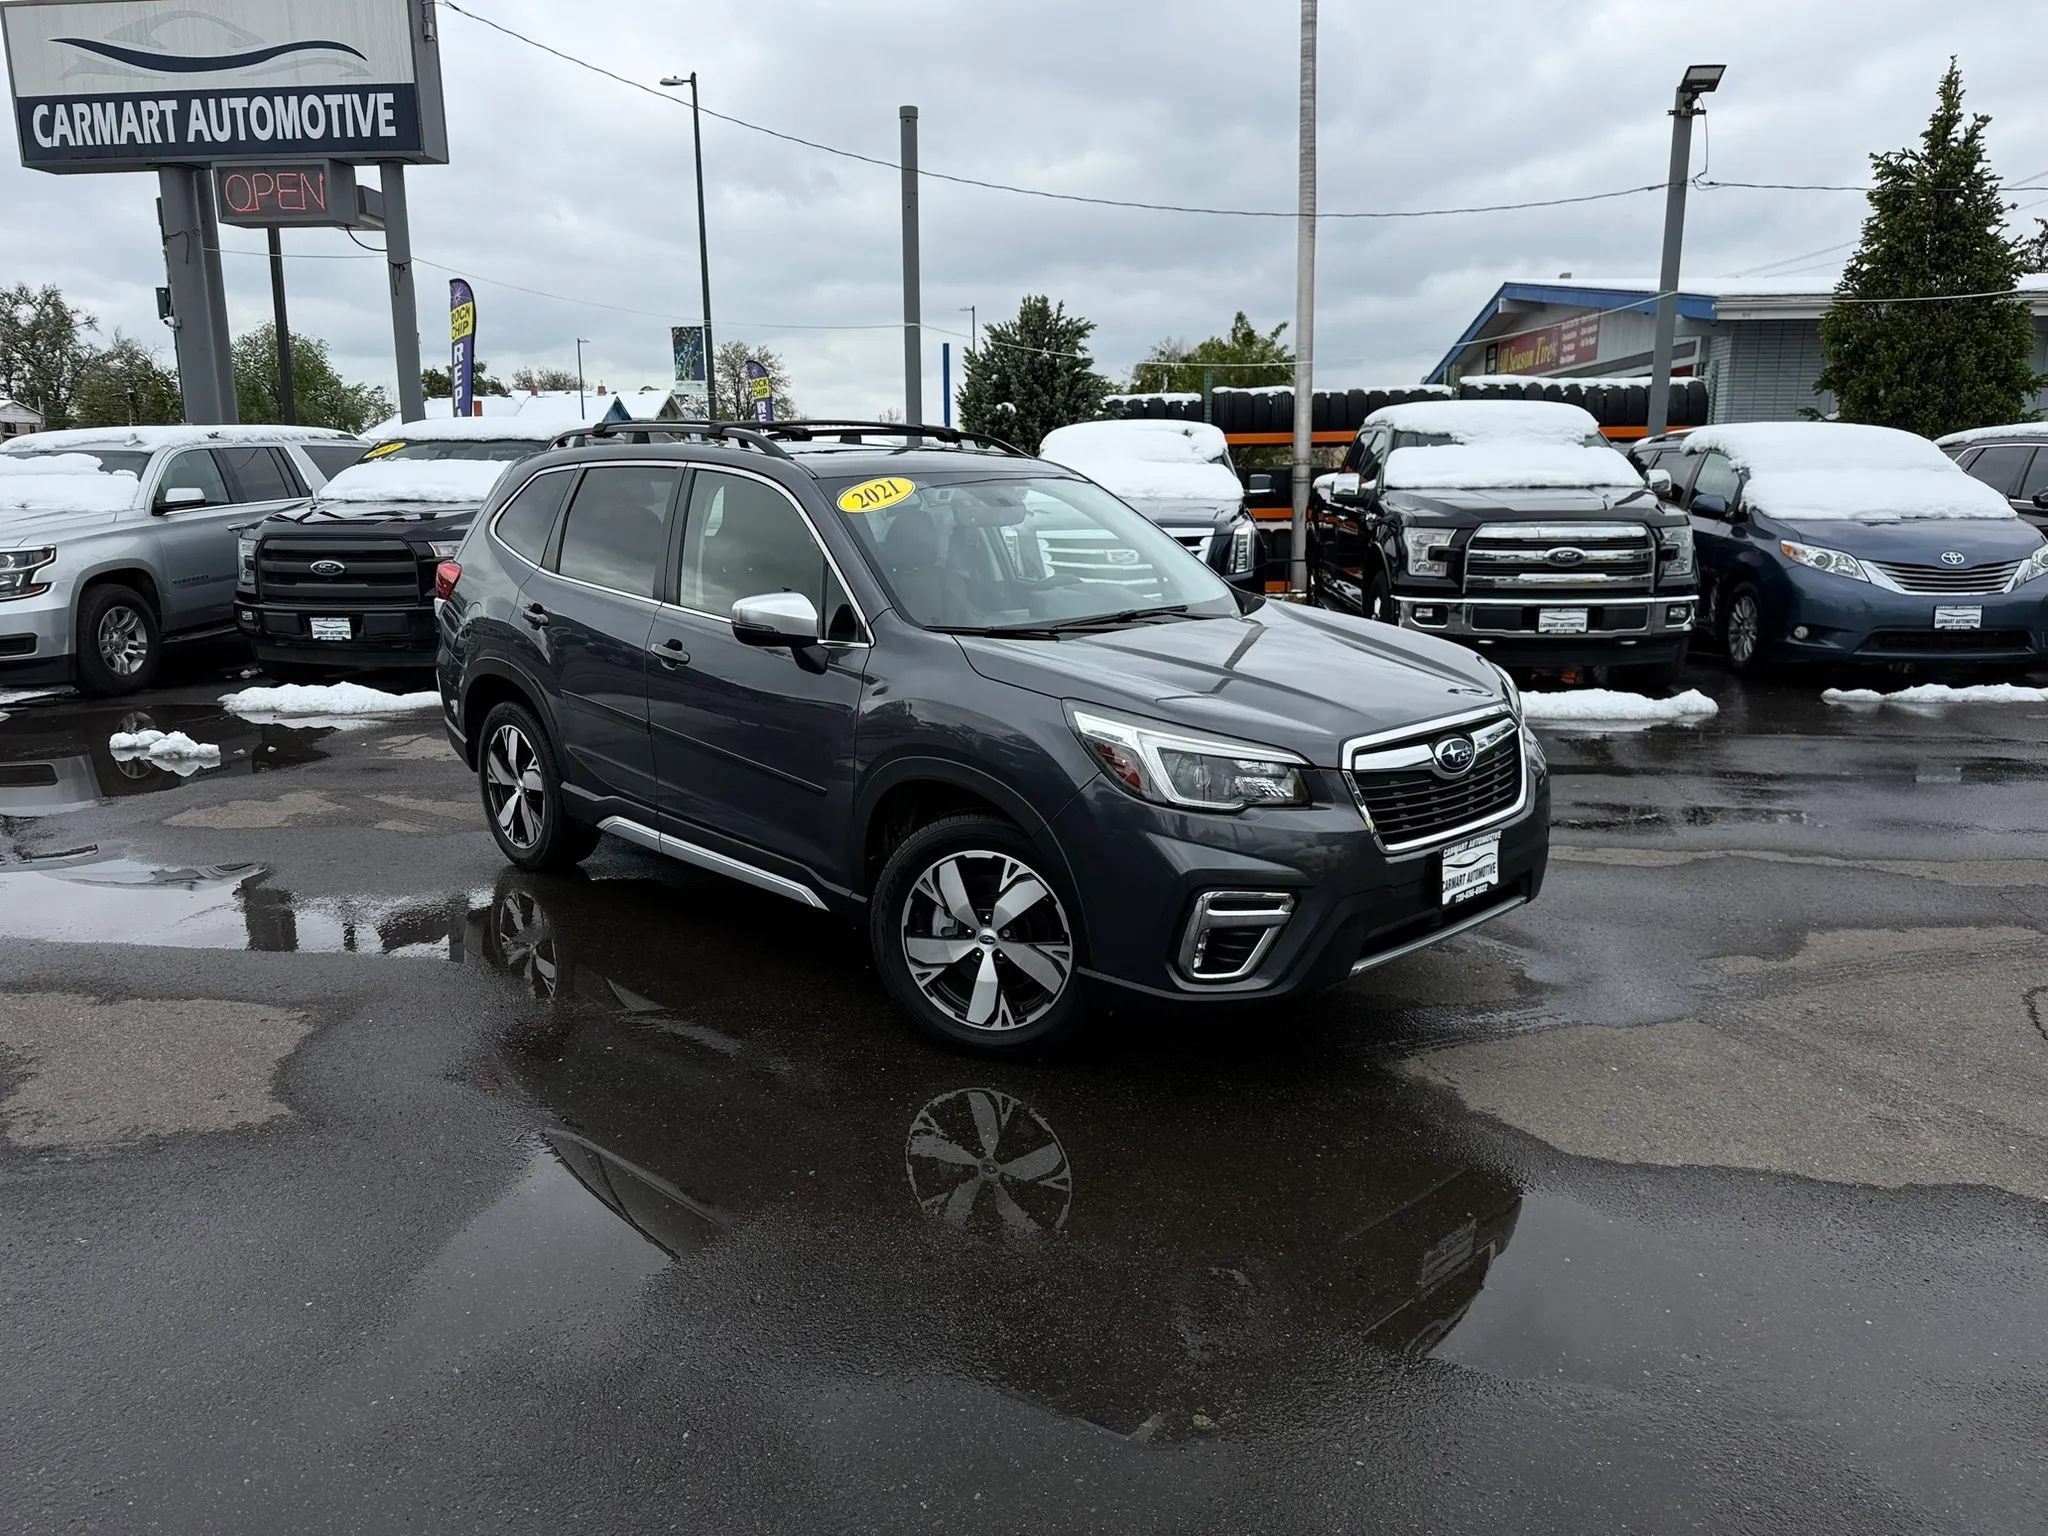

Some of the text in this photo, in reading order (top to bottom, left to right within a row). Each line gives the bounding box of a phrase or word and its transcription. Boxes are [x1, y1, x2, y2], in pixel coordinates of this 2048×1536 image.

[32, 92, 397, 148] CARMART AUTOMOTIVE
[224, 172, 326, 212] OPEN
[1535, 335, 1552, 366] Tire
[852, 479, 901, 509] 2021
[1466, 862, 1496, 883] AUTOMOTIVE
